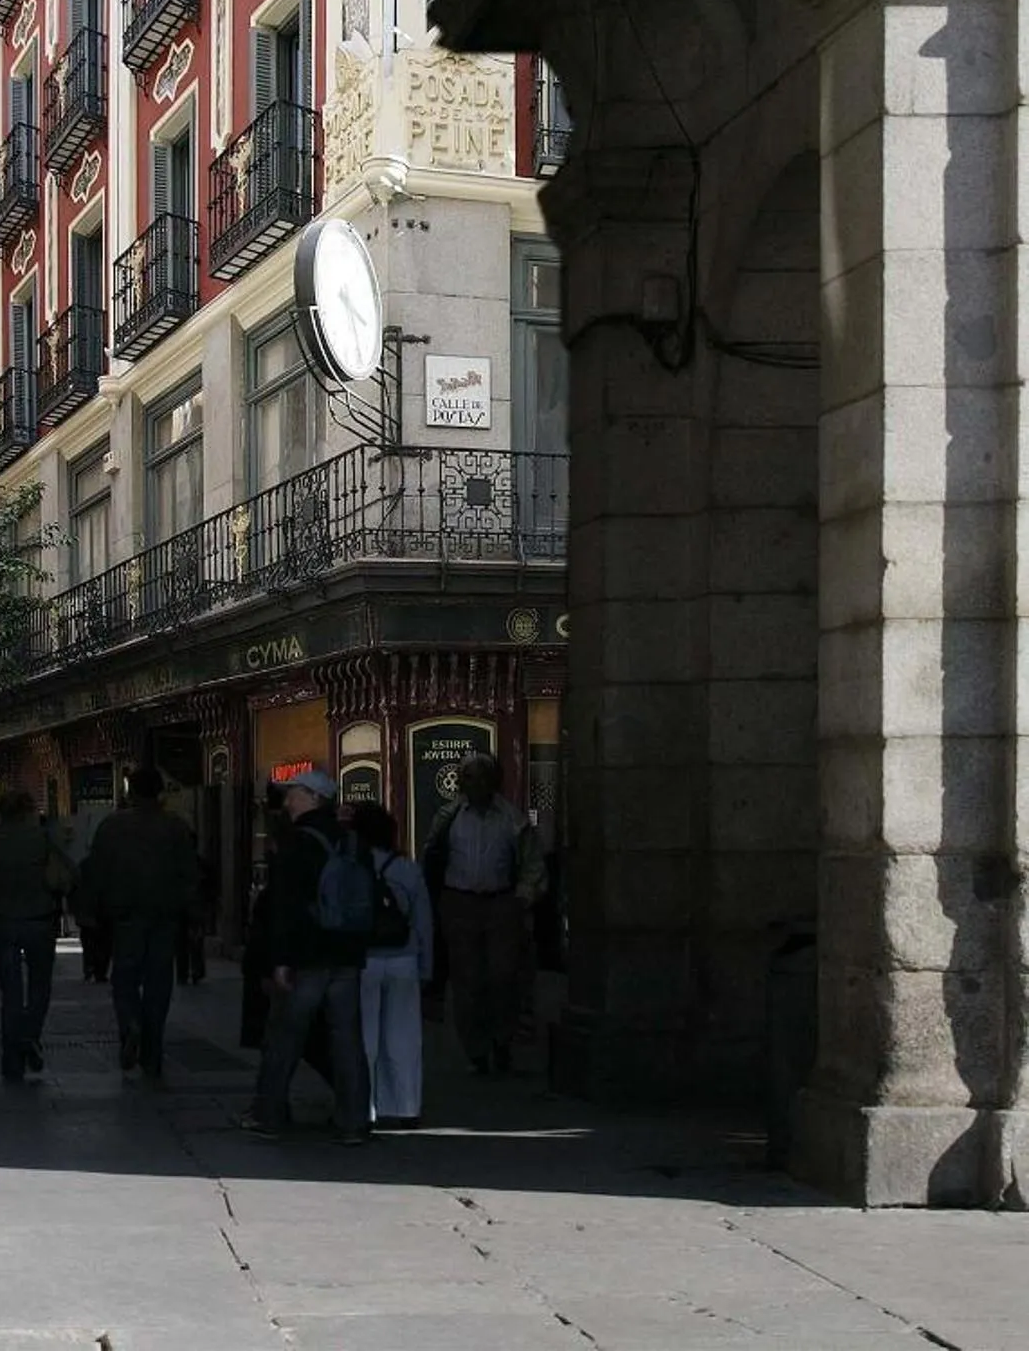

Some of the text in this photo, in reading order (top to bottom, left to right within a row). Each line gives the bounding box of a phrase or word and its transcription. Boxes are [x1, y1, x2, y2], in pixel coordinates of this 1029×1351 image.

[408, 72, 504, 109] POSADA
[409, 120, 505, 157] PEINE
[431, 397, 471, 409] CALLE
[246, 635, 304, 669] CYMA
